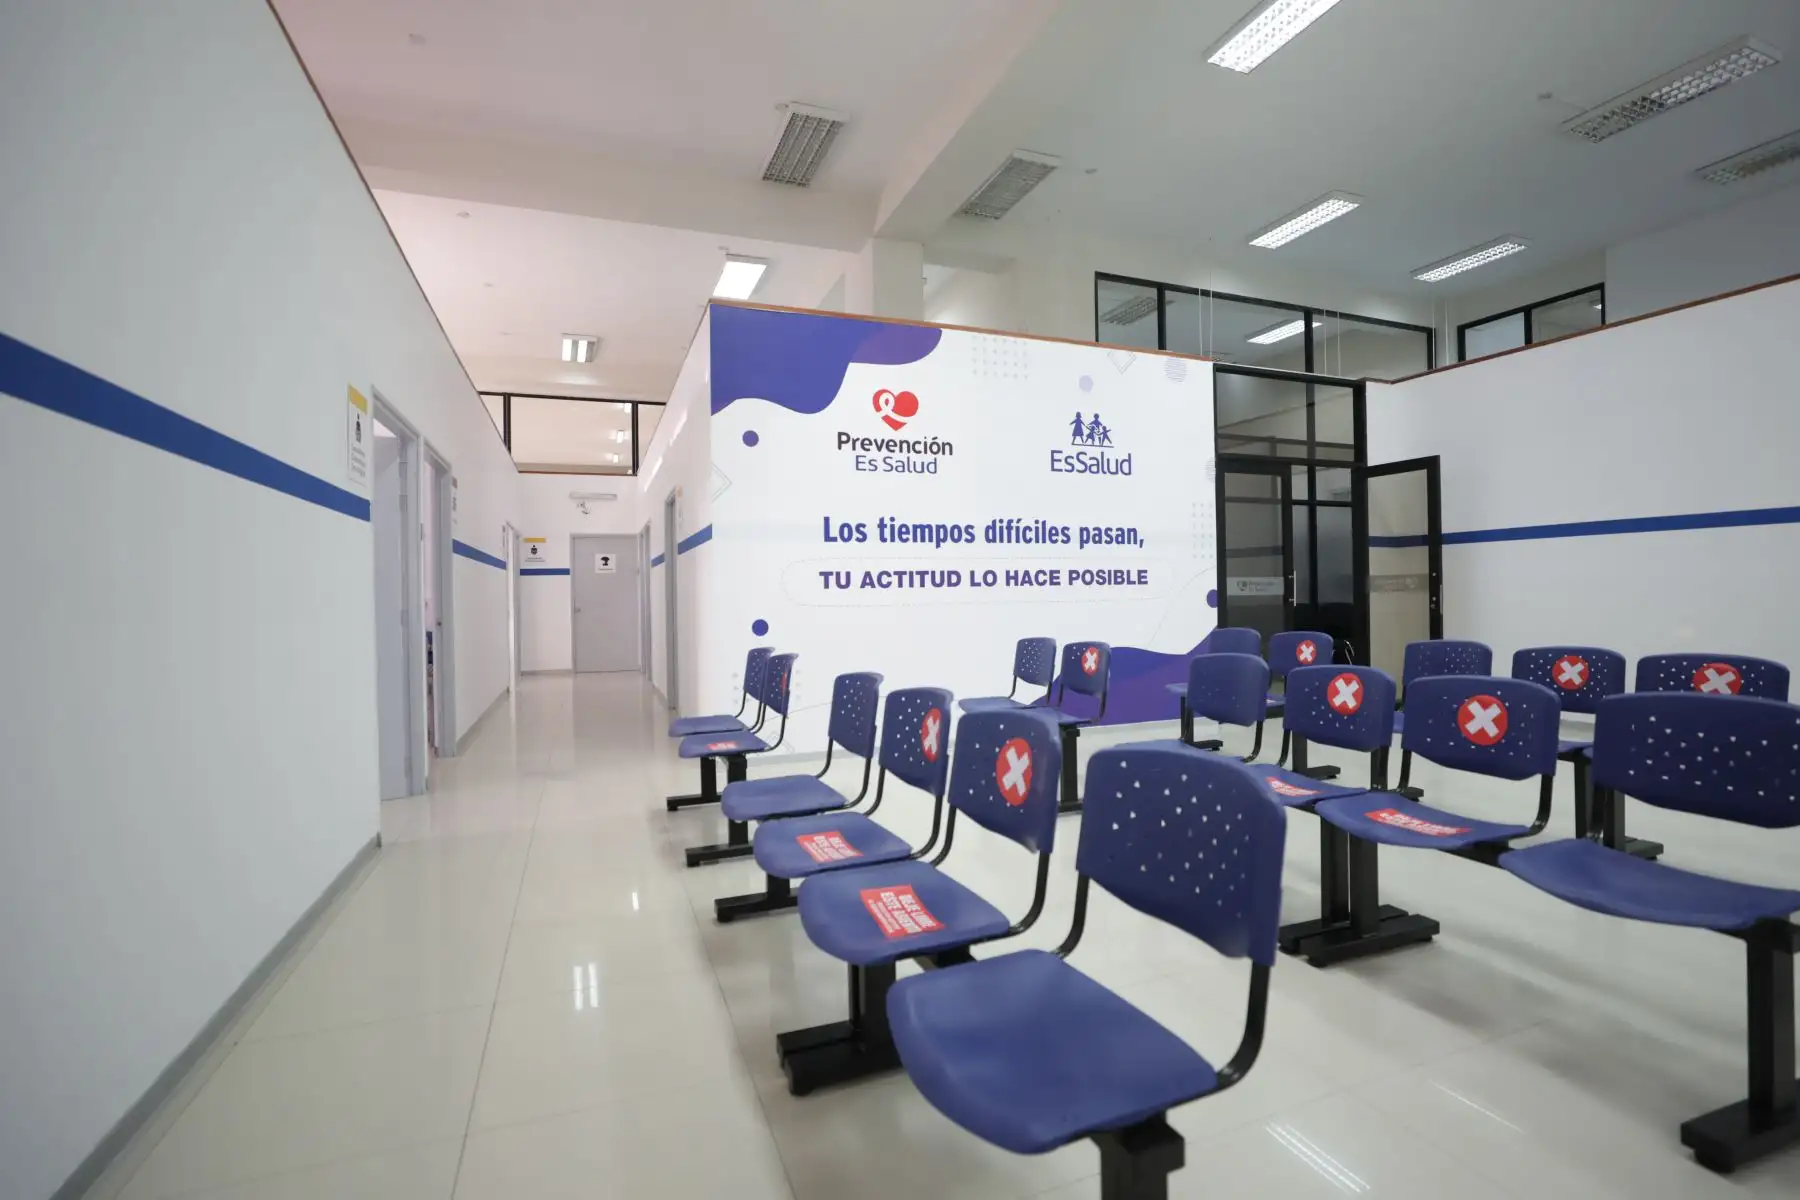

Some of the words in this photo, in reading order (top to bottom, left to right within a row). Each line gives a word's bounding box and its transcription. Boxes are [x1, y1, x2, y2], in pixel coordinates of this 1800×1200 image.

[837, 431, 953, 456] Prevención
[855, 454, 878, 472] Es
[882, 456, 938, 474] Salud
[1050, 449, 1132, 476] EsSalud
[823, 516, 868, 544] Los
[877, 516, 976, 549] tiempos
[984, 518, 1071, 545] difíciles
[1079, 526, 1145, 550] pasan,
[818, 570, 851, 590] TU
[859, 570, 962, 590] ACTITUD
[969, 569, 998, 588] LO
[1005, 569, 1061, 588] HACE
[1068, 568, 1148, 587] POSIBLE
